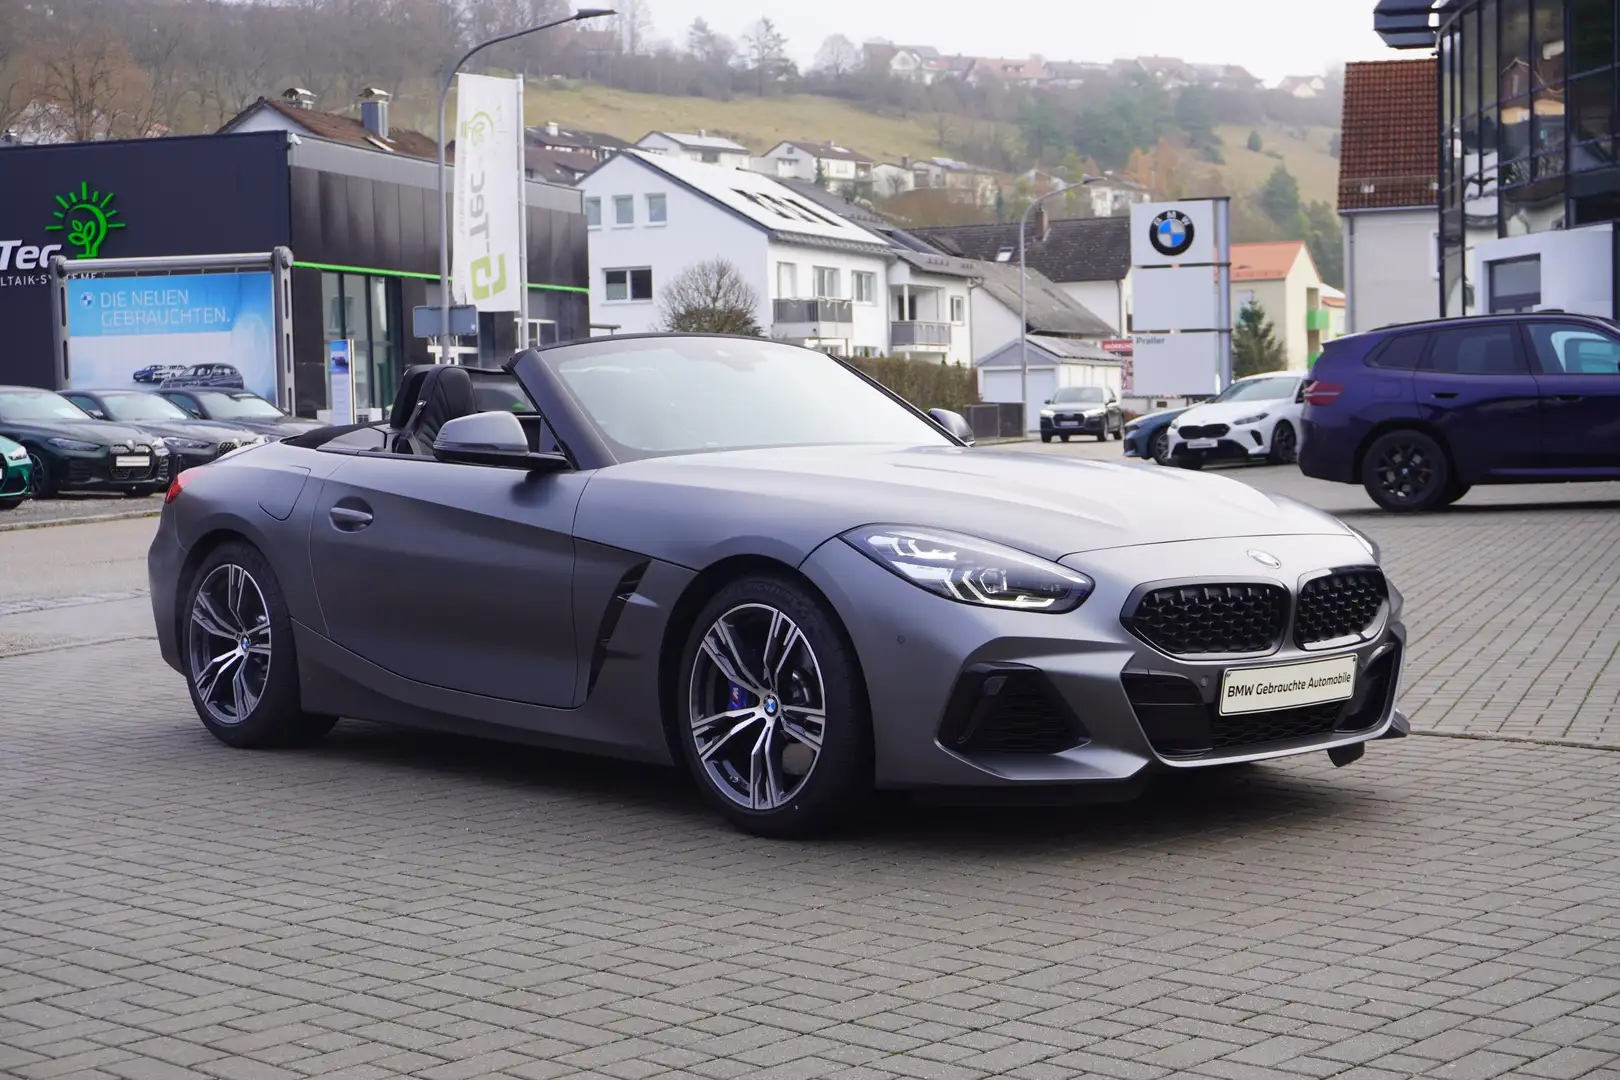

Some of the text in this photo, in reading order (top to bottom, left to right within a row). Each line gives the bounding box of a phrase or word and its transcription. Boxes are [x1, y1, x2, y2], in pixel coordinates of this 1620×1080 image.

[100, 288, 189, 308] DIE NEUEN
[101, 307, 231, 327] GEBRAUCHTEN.
[1227, 672, 1351, 697] BMW Gebrauchte Automobile
